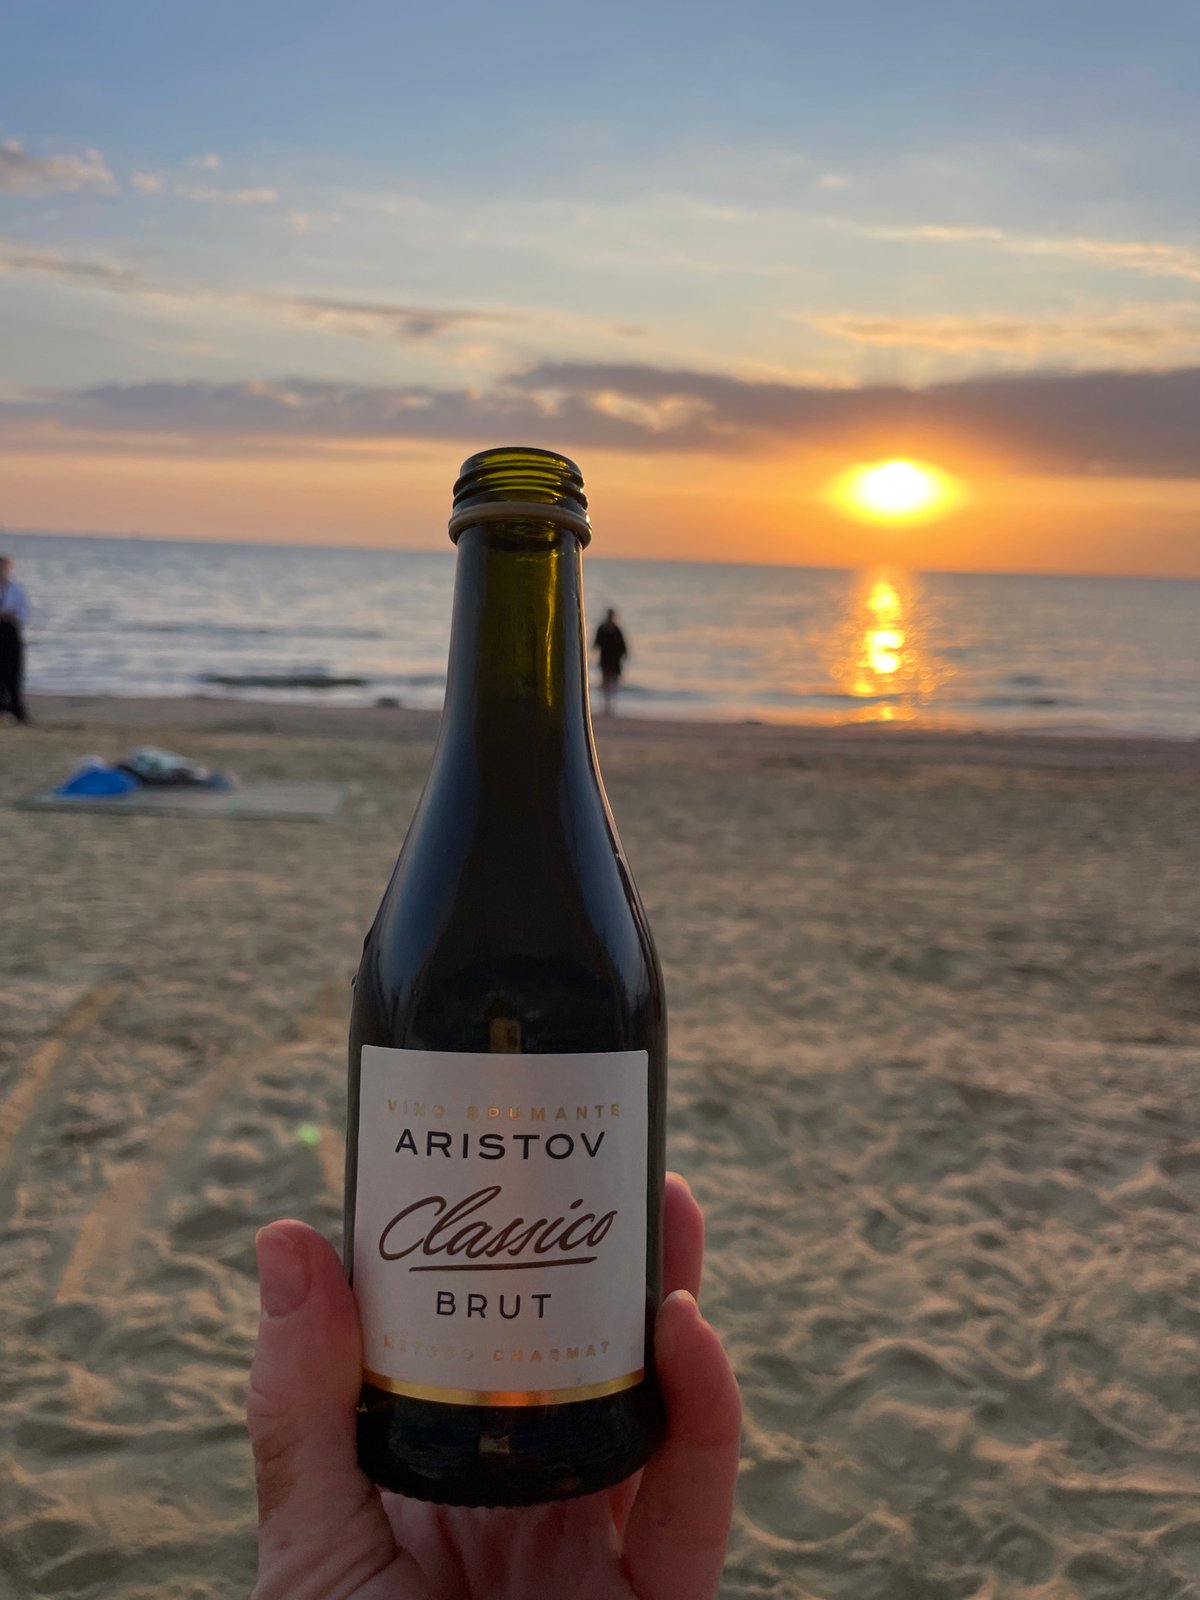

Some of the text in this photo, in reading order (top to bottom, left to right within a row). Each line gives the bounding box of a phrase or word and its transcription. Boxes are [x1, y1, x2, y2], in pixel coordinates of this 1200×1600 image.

[387, 1099, 620, 1122] VINO SPUMANTE
[395, 1128, 606, 1160] ARISTOV
[379, 1185, 618, 1261] Classico
[436, 1290, 552, 1320] BRUT
